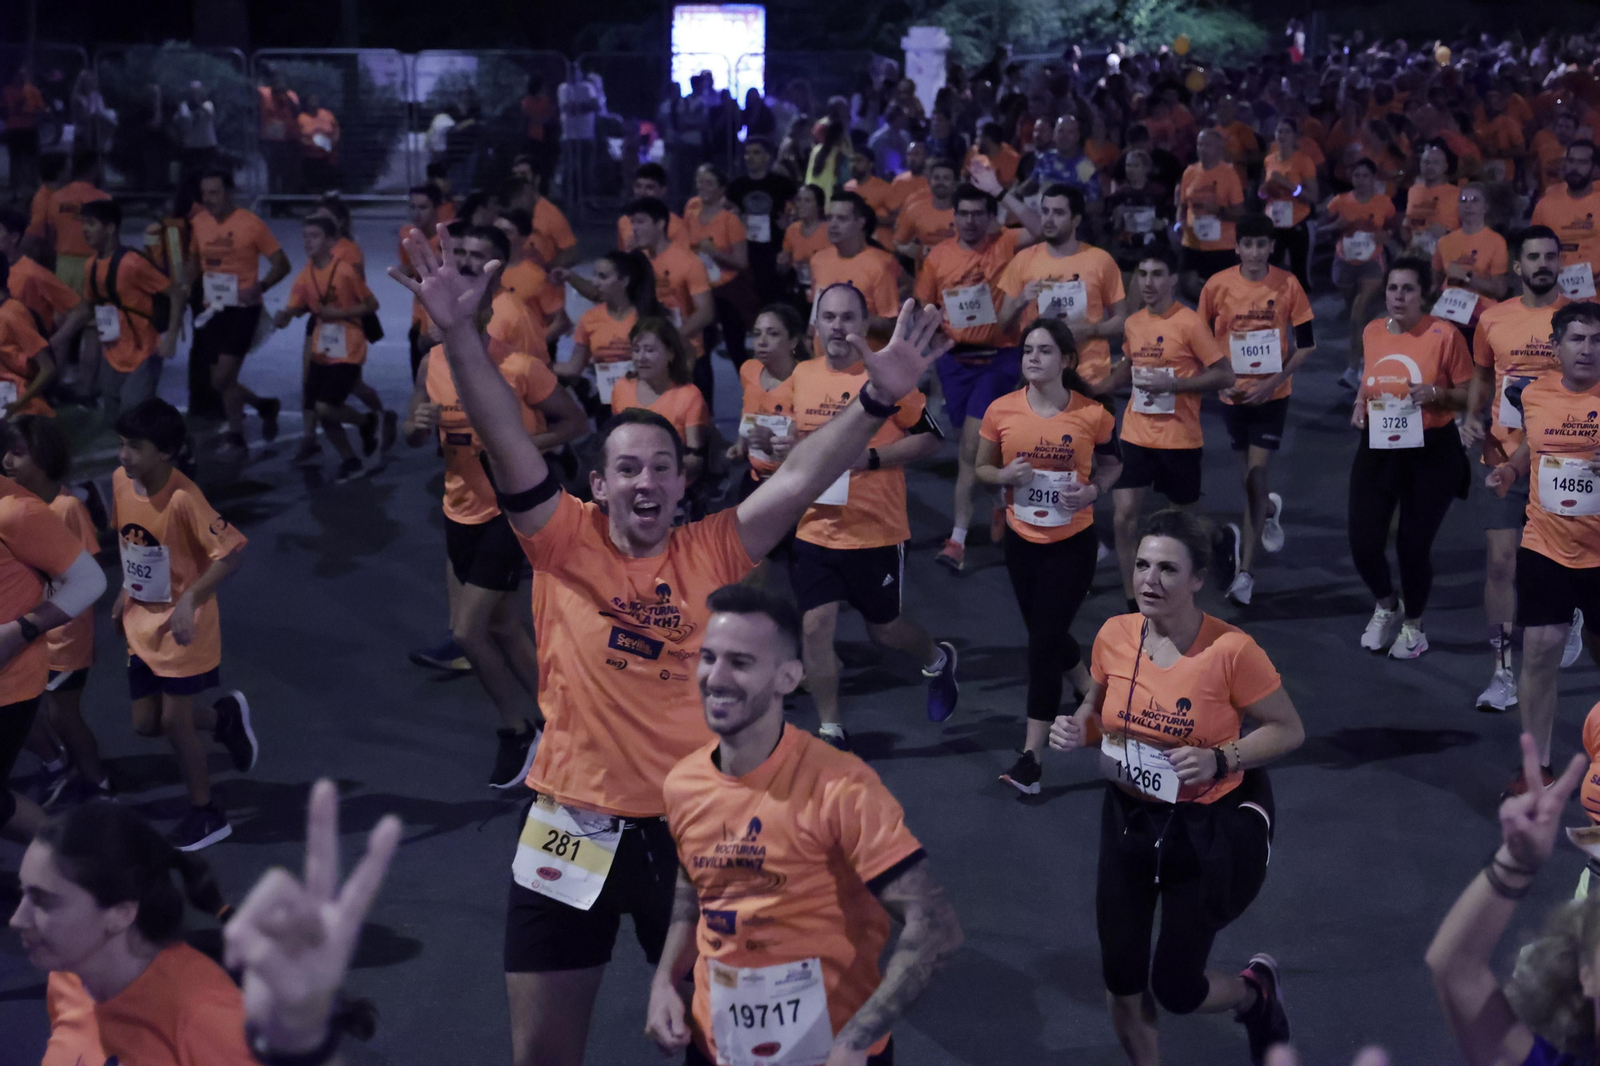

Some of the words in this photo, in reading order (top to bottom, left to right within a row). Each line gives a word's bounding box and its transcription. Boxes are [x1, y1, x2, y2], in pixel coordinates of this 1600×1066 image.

[958, 299, 981, 310] 4105
[1241, 345, 1270, 357] 16011
[1382, 417, 1408, 429] 3728
[1562, 422, 1599, 430] NOCTURNA
[1544, 428, 1577, 437] SEVILLA
[1016, 451, 1052, 459] SEVILLA
[1034, 446, 1075, 455] NOCTURNA
[1552, 476, 1593, 494] 14856
[1028, 488, 1060, 504] 2918
[126, 560, 152, 579] 2562
[1117, 710, 1161, 732] SEVILLA
[1141, 709, 1195, 727] NOCTURNA
[1116, 760, 1162, 792] 11266
[541, 829, 581, 862] 281
[714, 843, 766, 857] NOCTURNA
[693, 855, 735, 869] SEVILLA
[729, 998, 801, 1028] 19717
